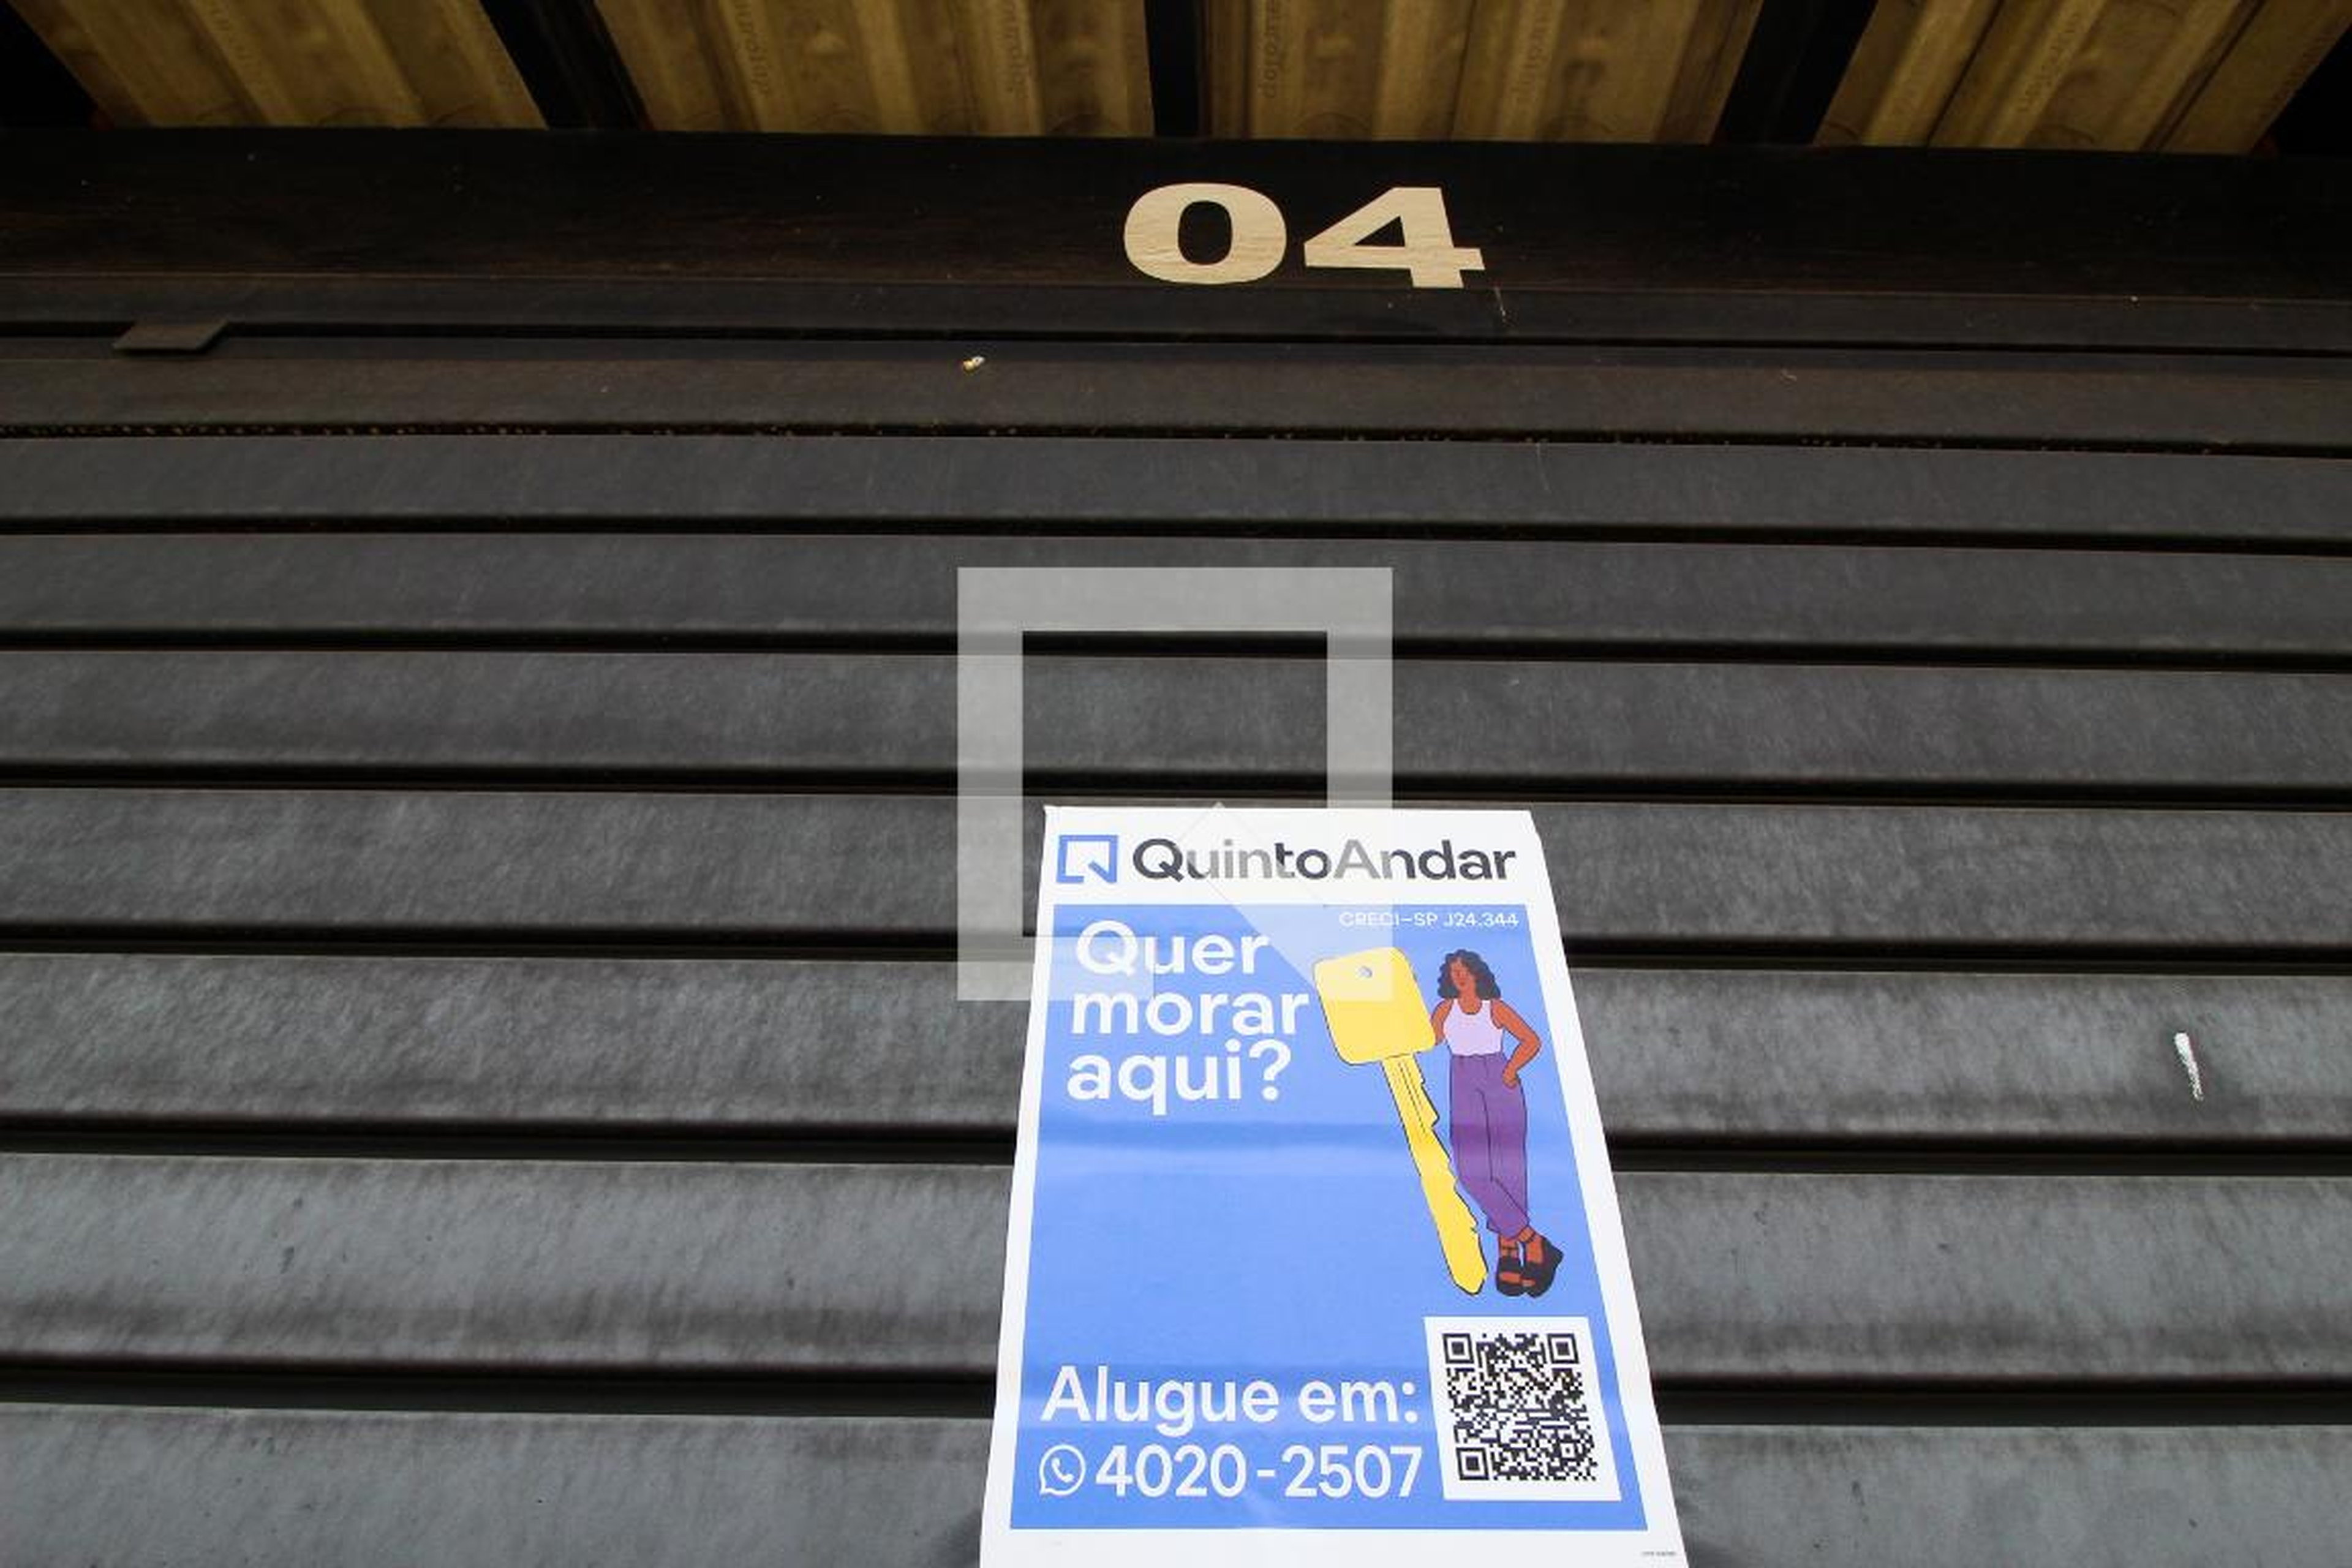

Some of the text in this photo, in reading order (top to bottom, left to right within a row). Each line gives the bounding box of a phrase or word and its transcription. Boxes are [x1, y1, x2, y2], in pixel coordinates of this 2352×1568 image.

[1123, 183, 1486, 289] 04
[1133, 838, 1516, 881] QuintoAndar
[1443, 911, 1519, 927] J24.344
[1076, 920, 1269, 975] Quer
[1071, 992, 1309, 1035] morar
[1068, 1039, 1292, 1115] aqui?
[1041, 1366, 1419, 1436] Alugue em:
